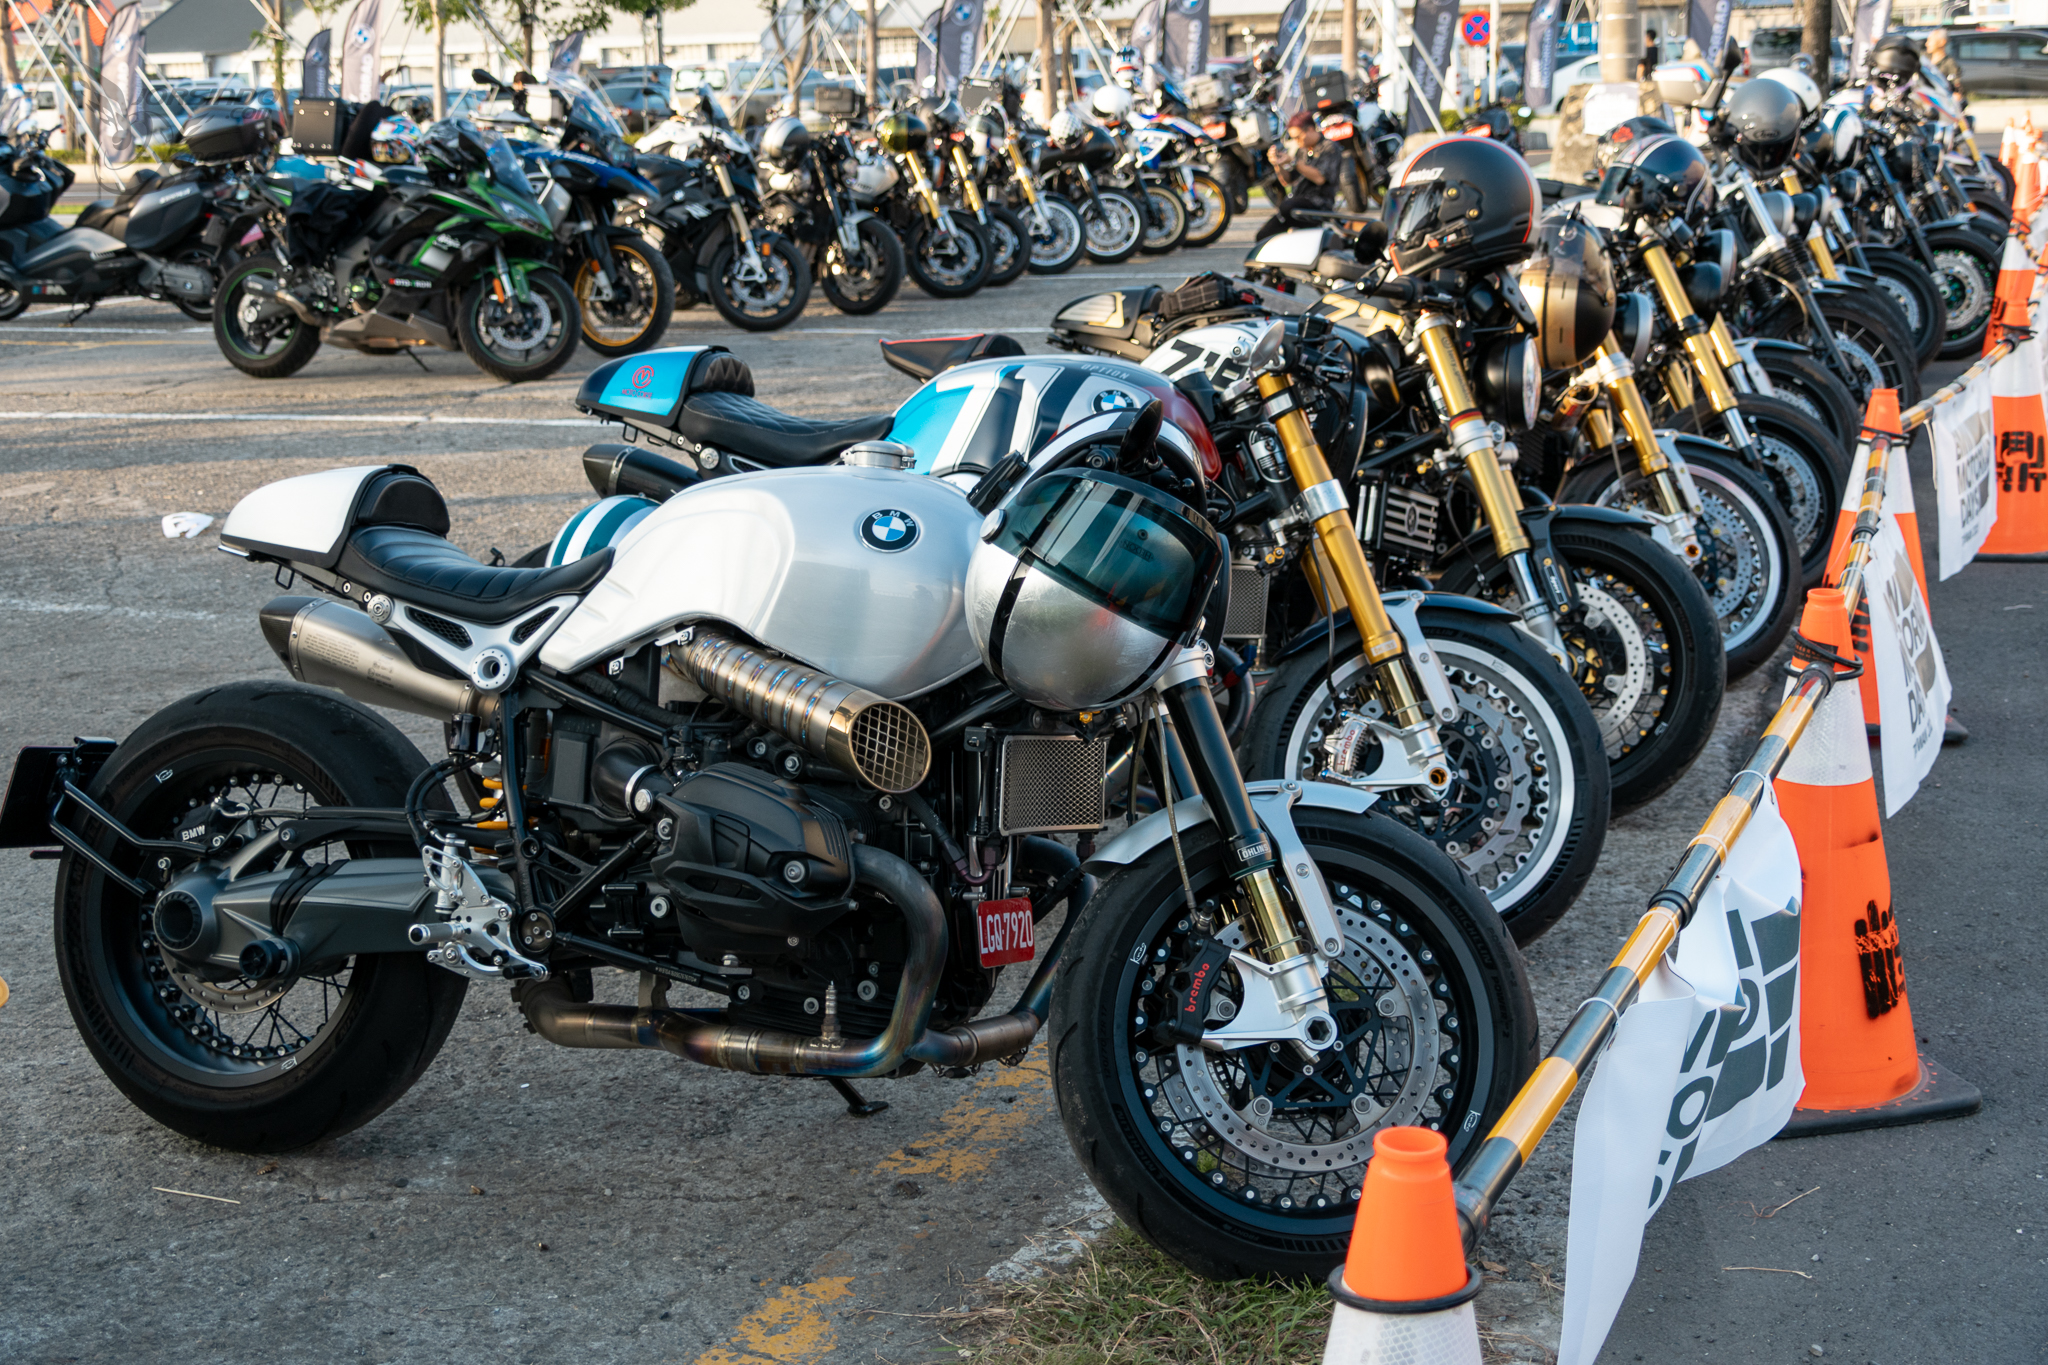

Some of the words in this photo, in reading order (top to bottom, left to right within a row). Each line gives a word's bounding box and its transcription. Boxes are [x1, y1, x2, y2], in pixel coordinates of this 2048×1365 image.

[1081, 363, 1130, 379] OPTION
[1100, 390, 1132, 403] BMW
[871, 510, 915, 527] BMW
[1337, 730, 1356, 766] brembo
[182, 825, 205, 840] BMW
[1241, 844, 1269, 859] ÖHLINS
[979, 910, 1033, 955] LGQ-7920
[1453, 904, 1493, 966] MICHELIN
[1184, 962, 1210, 1013] brembo
